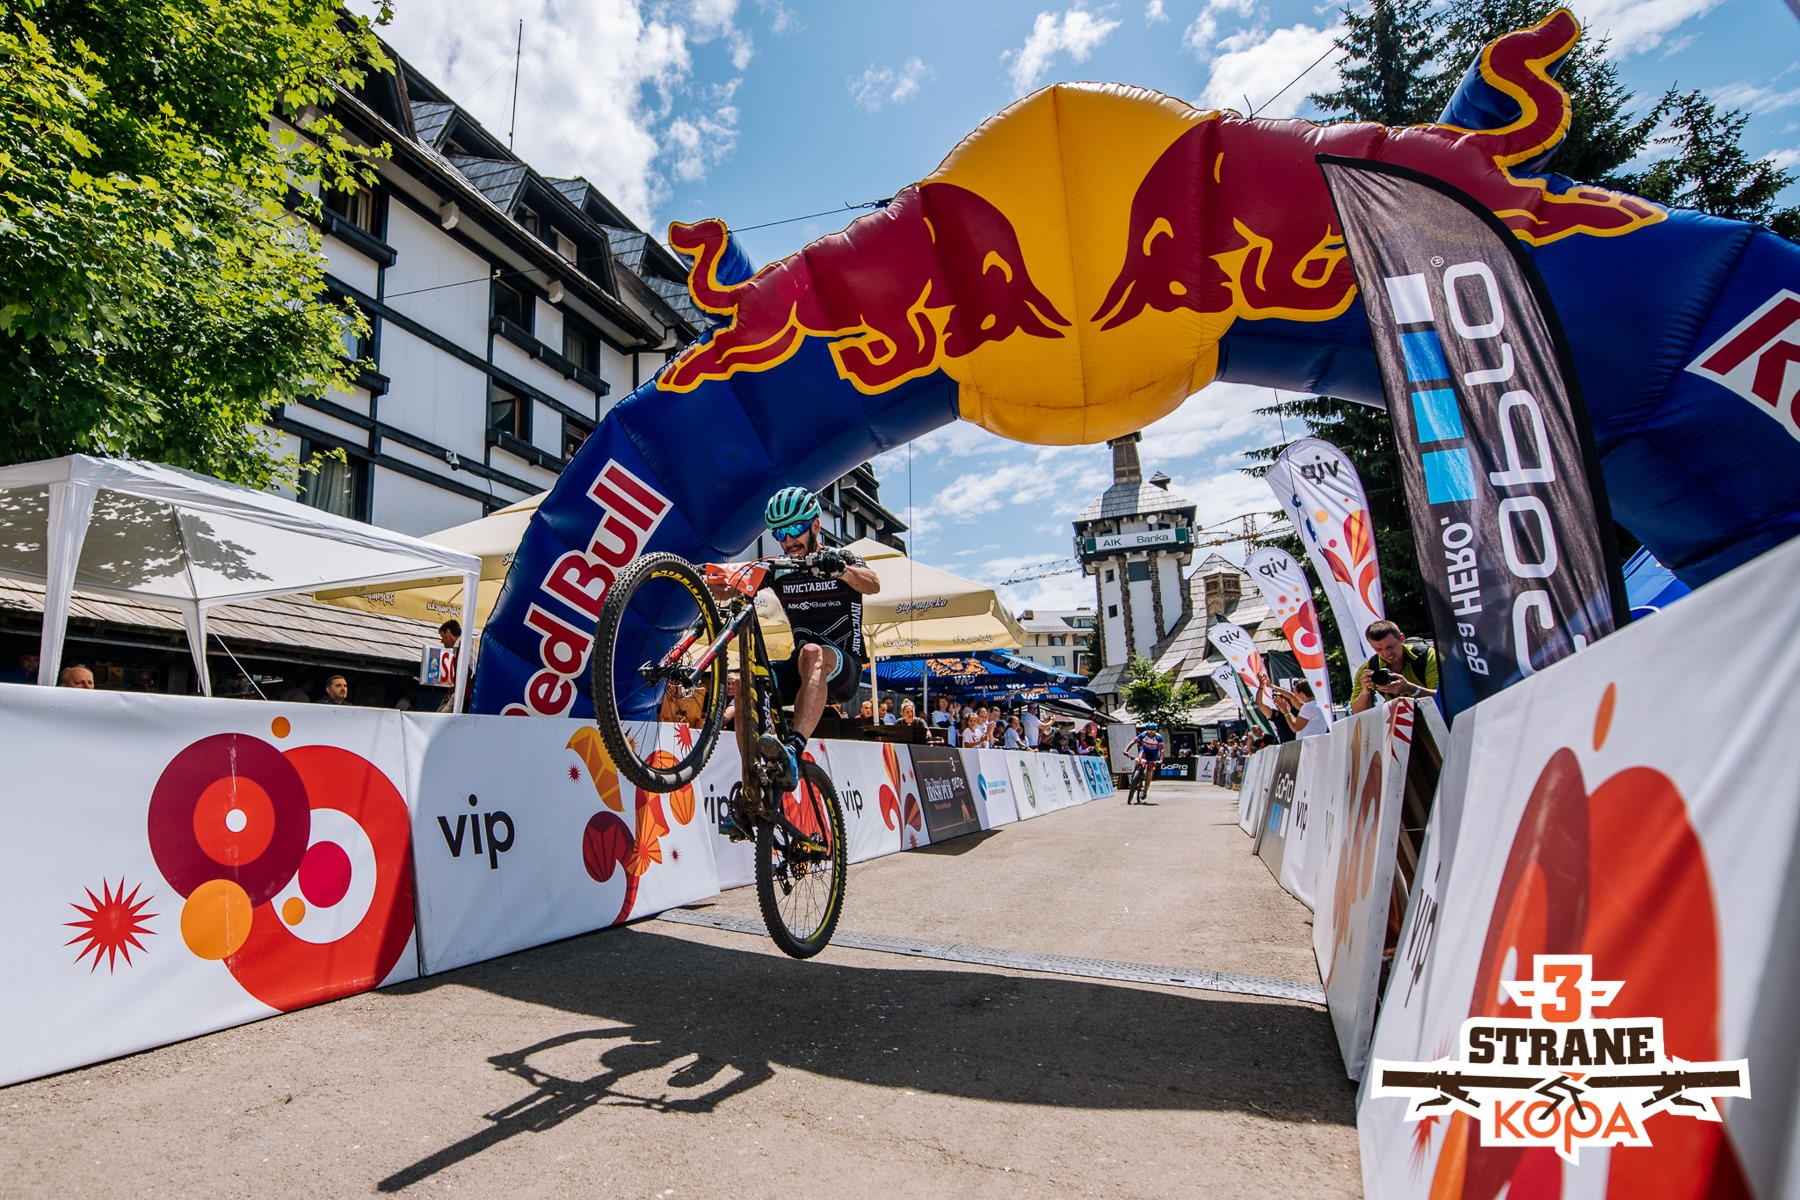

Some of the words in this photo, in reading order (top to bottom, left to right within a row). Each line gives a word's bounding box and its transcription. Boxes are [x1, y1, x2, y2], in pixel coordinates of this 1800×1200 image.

[541, 458, 673, 621] Bull
[1103, 539, 1122, 548] AIK
[1137, 534, 1169, 544] Banka
[783, 580, 838, 594] INVICTABIKE
[811, 601, 841, 609] Banka
[851, 601, 862, 657] INVICTABIK
[501, 602, 595, 717] ed
[841, 781, 863, 818] vip
[436, 793, 515, 870] vip
